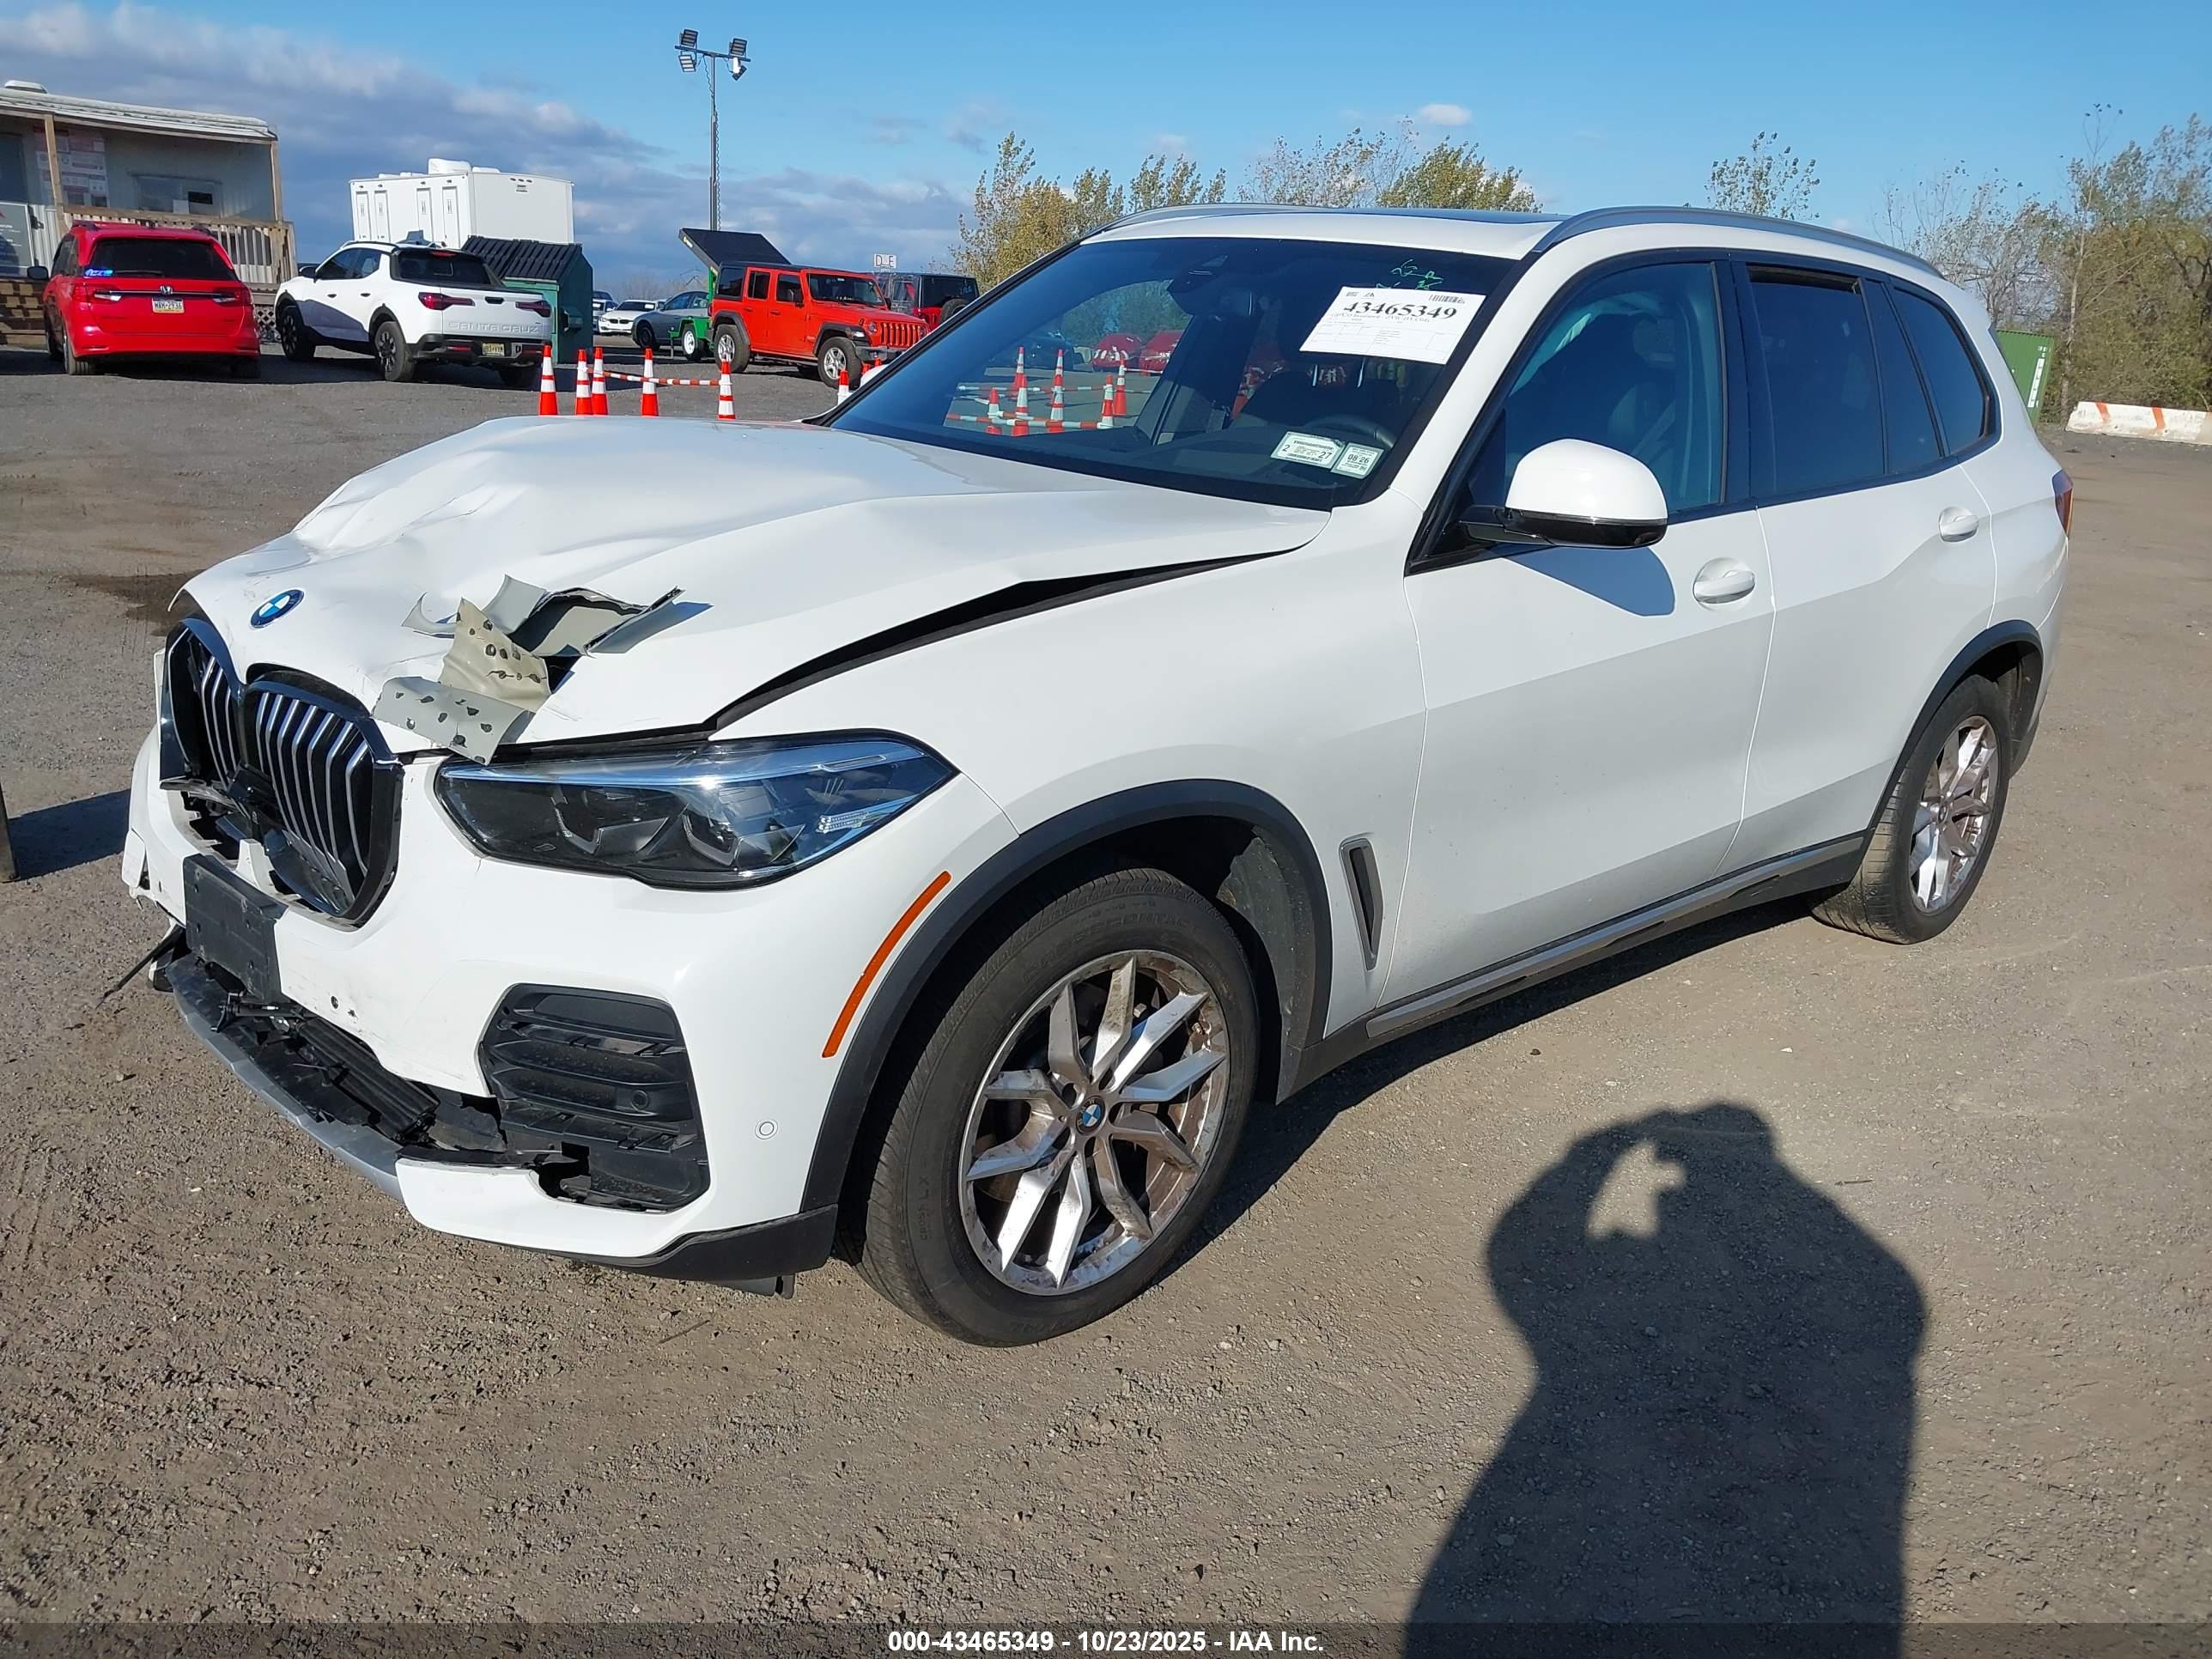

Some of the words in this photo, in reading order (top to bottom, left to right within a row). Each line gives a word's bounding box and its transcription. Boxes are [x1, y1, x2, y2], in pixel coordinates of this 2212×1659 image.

[1343, 301, 1457, 319] 43465349
[447, 321, 498, 331] SANTA
[501, 324, 540, 334] CRUZ
[1281, 444, 1291, 453] 2
[1317, 451, 1333, 459] 27
[1347, 453, 1358, 462] 08
[1358, 456, 1370, 465] 26
